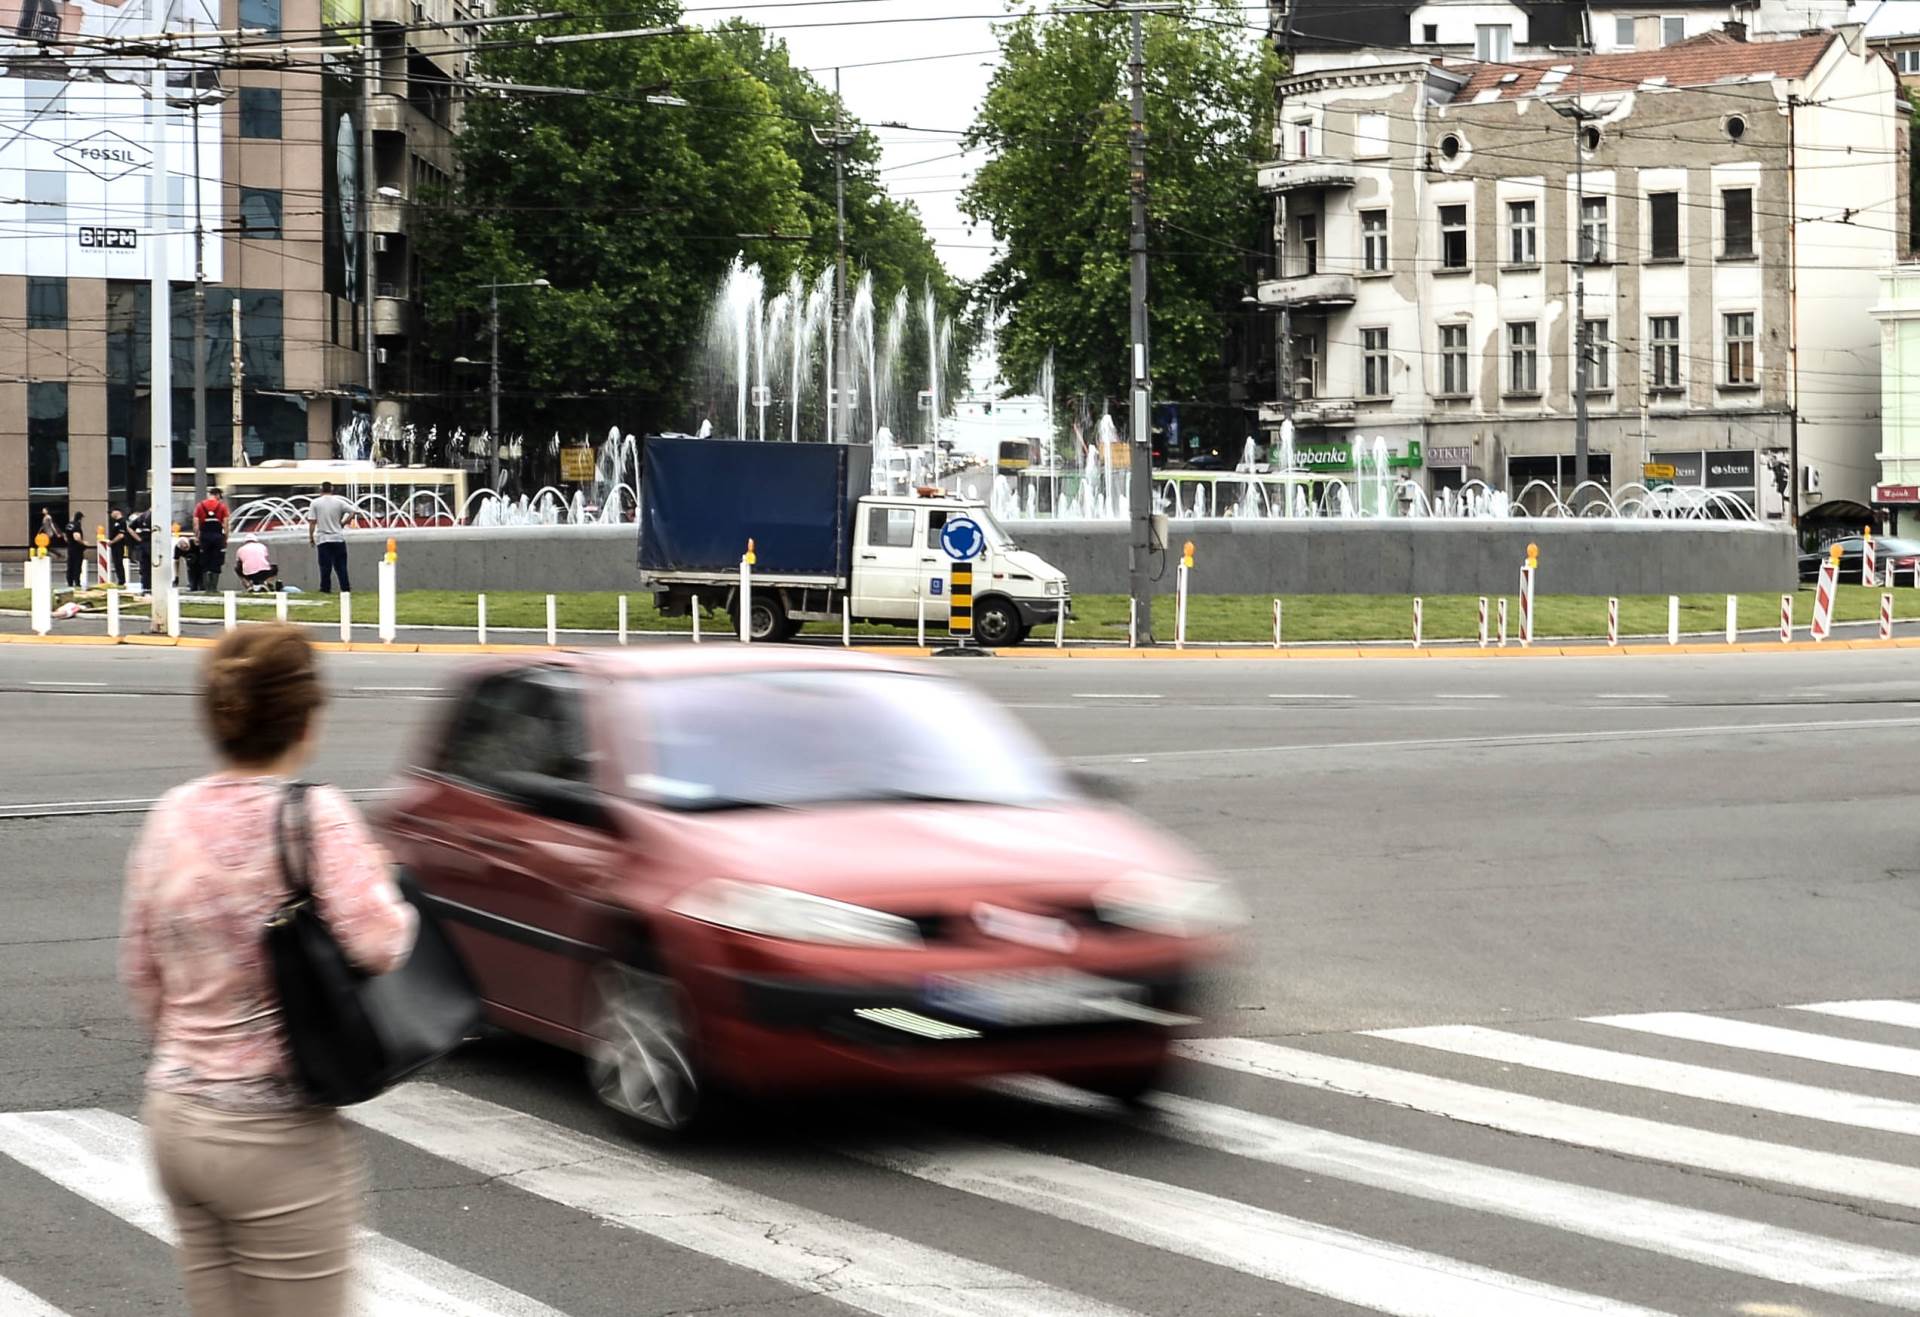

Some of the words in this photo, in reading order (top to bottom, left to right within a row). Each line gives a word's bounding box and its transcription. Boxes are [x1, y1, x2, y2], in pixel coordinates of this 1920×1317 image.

[80, 148, 135, 162] FOSSIL
[1428, 447, 1469, 459] OTKUP
[1675, 467, 1696, 477] tem
